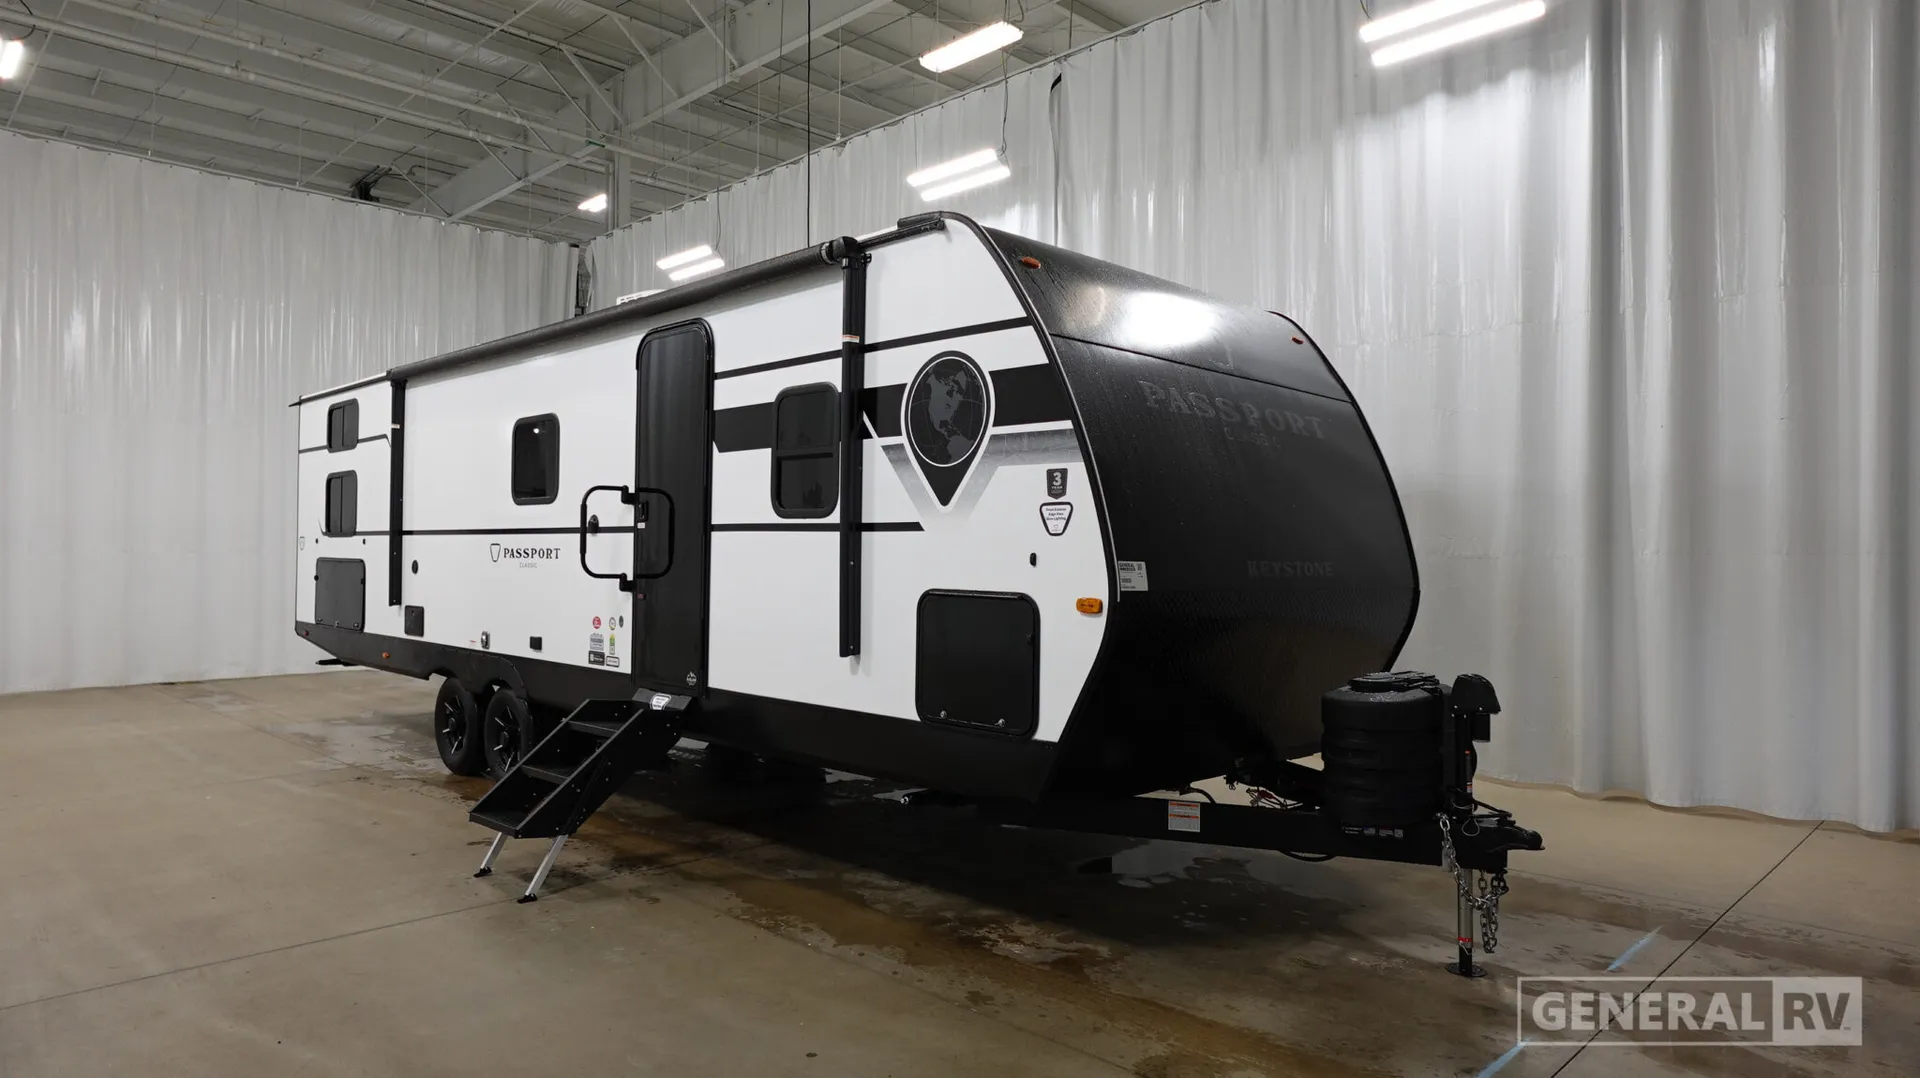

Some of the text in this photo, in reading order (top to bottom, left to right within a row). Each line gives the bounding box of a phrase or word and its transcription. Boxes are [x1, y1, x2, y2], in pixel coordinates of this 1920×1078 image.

[1136, 380, 1325, 439] PASSPORT
[1052, 471, 1062, 486] 3
[503, 547, 561, 560] PASSPORT
[1247, 560, 1334, 578] KEYSTONE
